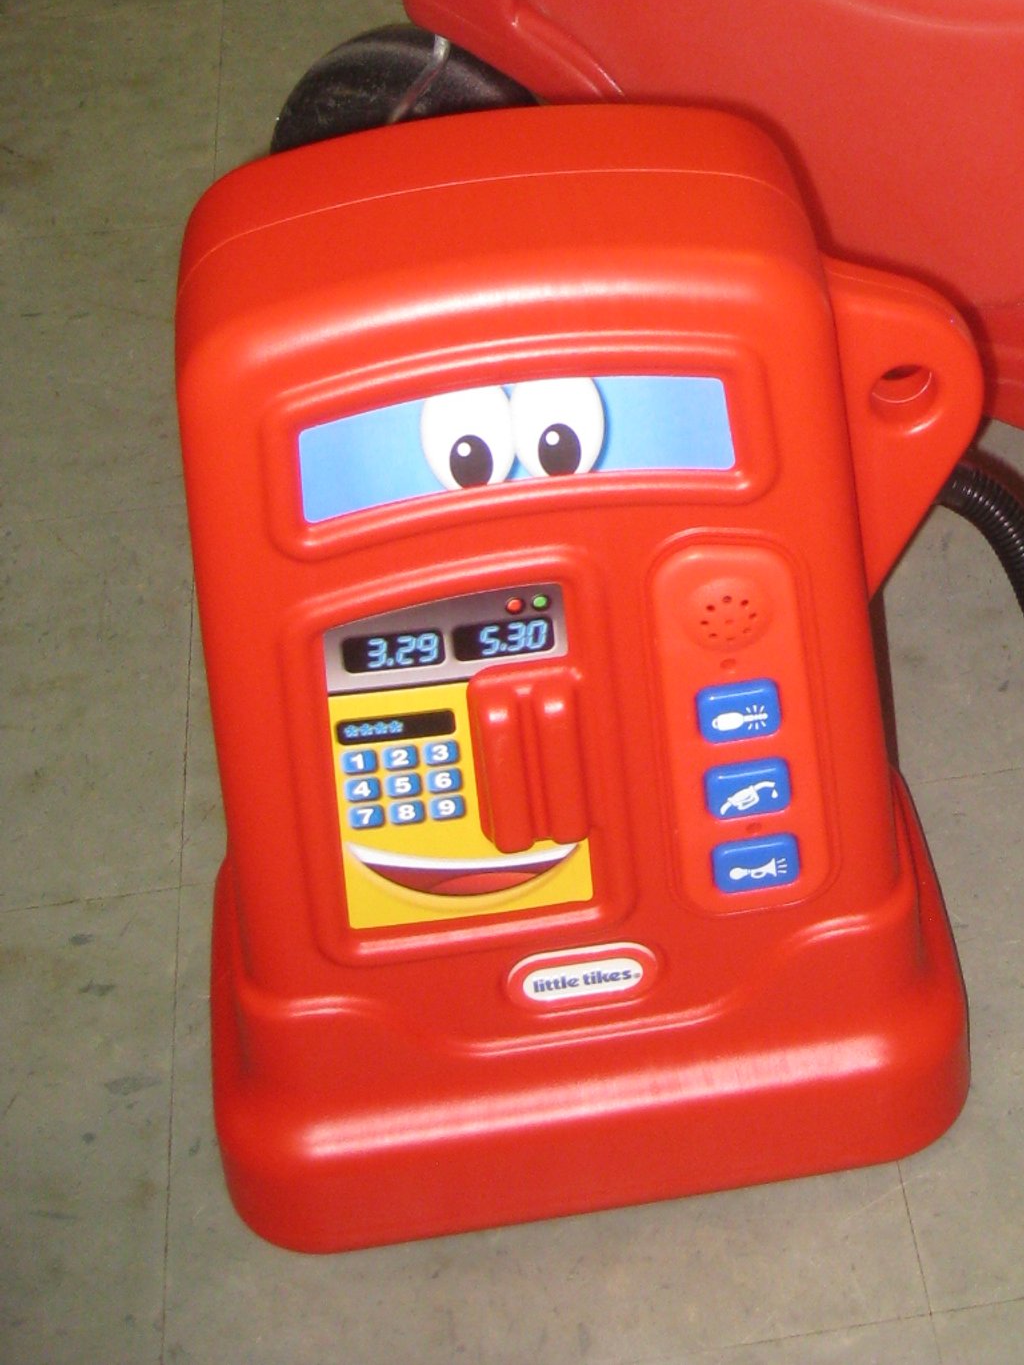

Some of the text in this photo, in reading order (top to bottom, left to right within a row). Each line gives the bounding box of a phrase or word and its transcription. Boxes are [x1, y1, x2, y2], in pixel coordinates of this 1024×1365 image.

[479, 620, 547, 656] 5.30
[367, 633, 439, 668] 3.29
[351, 745, 449, 769] 1 2 3
[353, 773, 452, 797] 4 5 6
[357, 800, 456, 824] 7 8 9
[533, 969, 632, 993] little tikes
